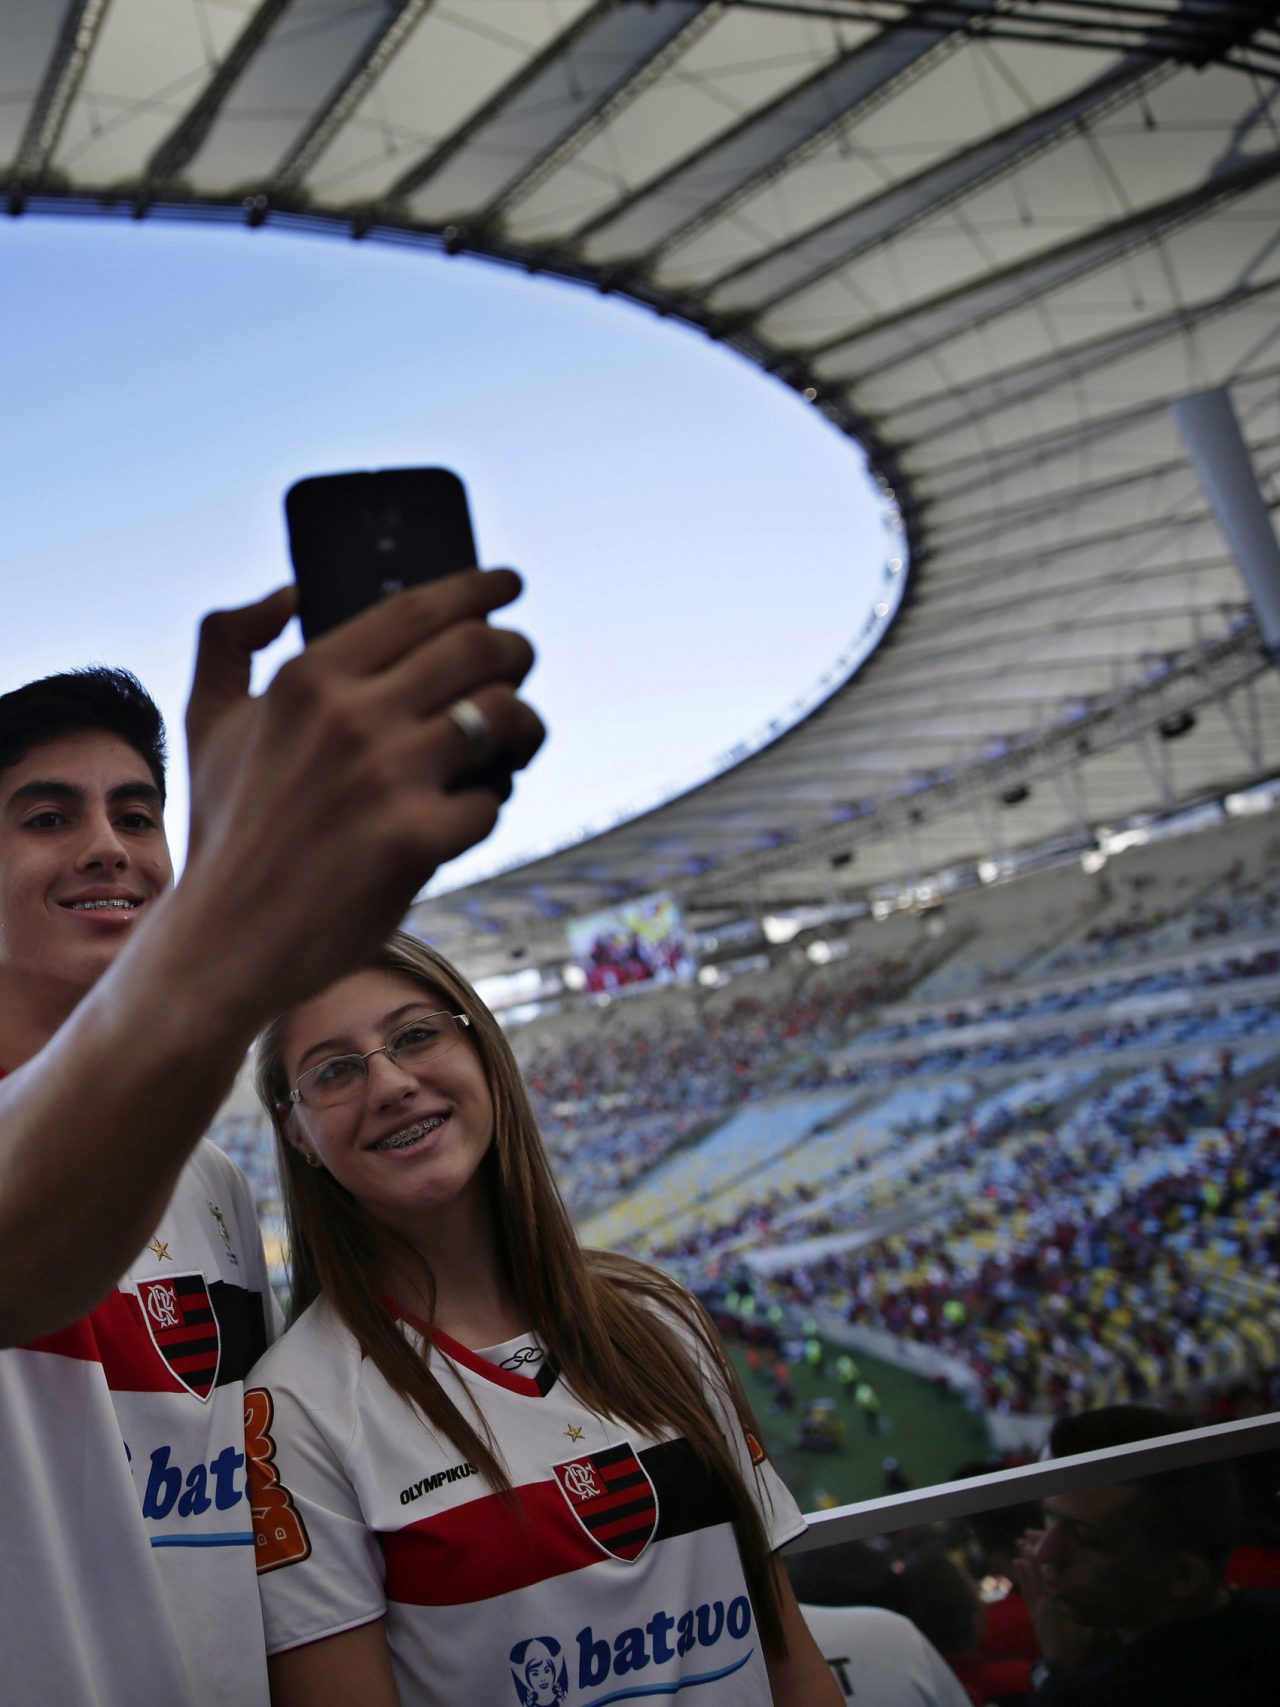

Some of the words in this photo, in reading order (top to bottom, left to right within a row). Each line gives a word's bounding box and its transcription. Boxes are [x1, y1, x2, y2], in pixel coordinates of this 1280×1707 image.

[142, 1445, 251, 1520] bat
[399, 1462, 480, 1506] OLYMPIKUS
[575, 1595, 752, 1690] batavo
